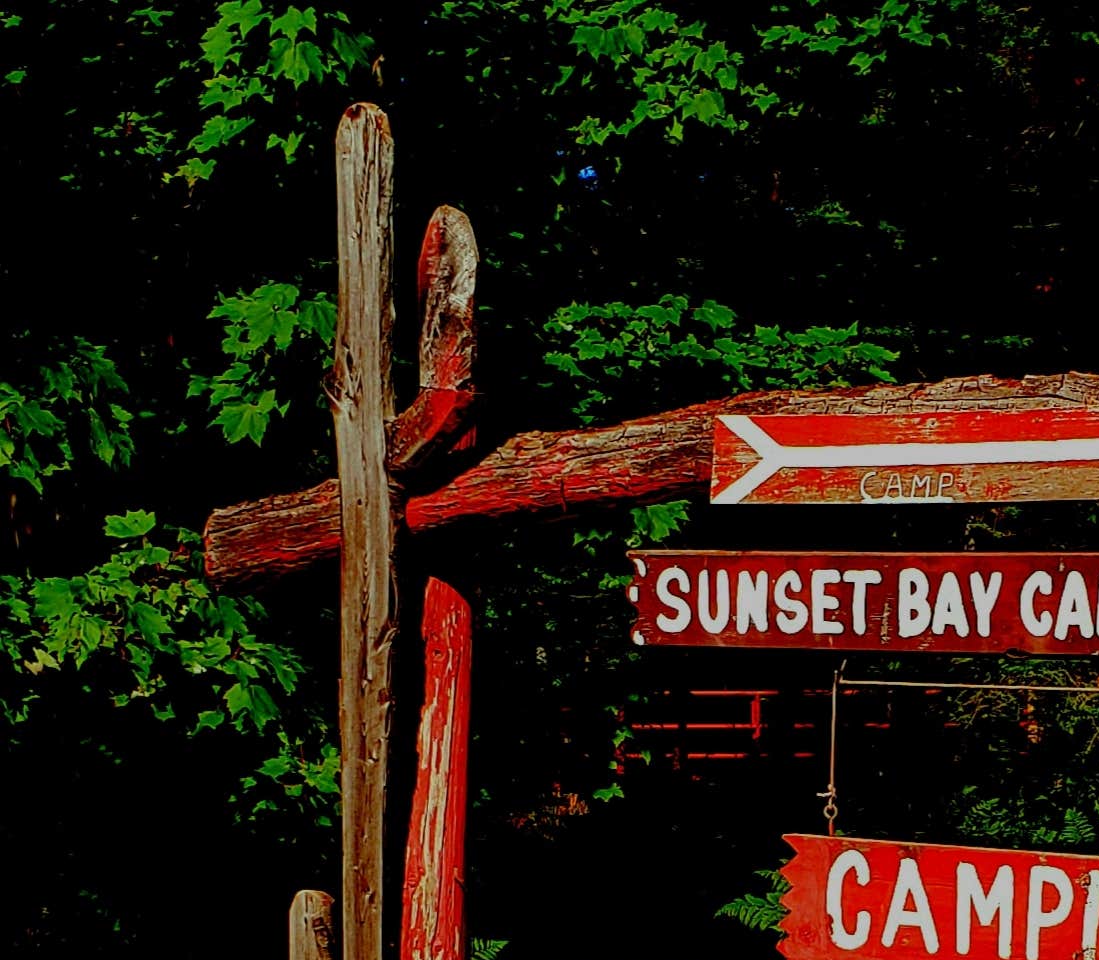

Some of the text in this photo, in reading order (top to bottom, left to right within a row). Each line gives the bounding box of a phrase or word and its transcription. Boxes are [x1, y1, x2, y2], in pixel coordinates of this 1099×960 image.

[861, 471, 954, 500] CAMP
[656, 566, 885, 634] SUNSET
[898, 568, 1003, 638] BAY
